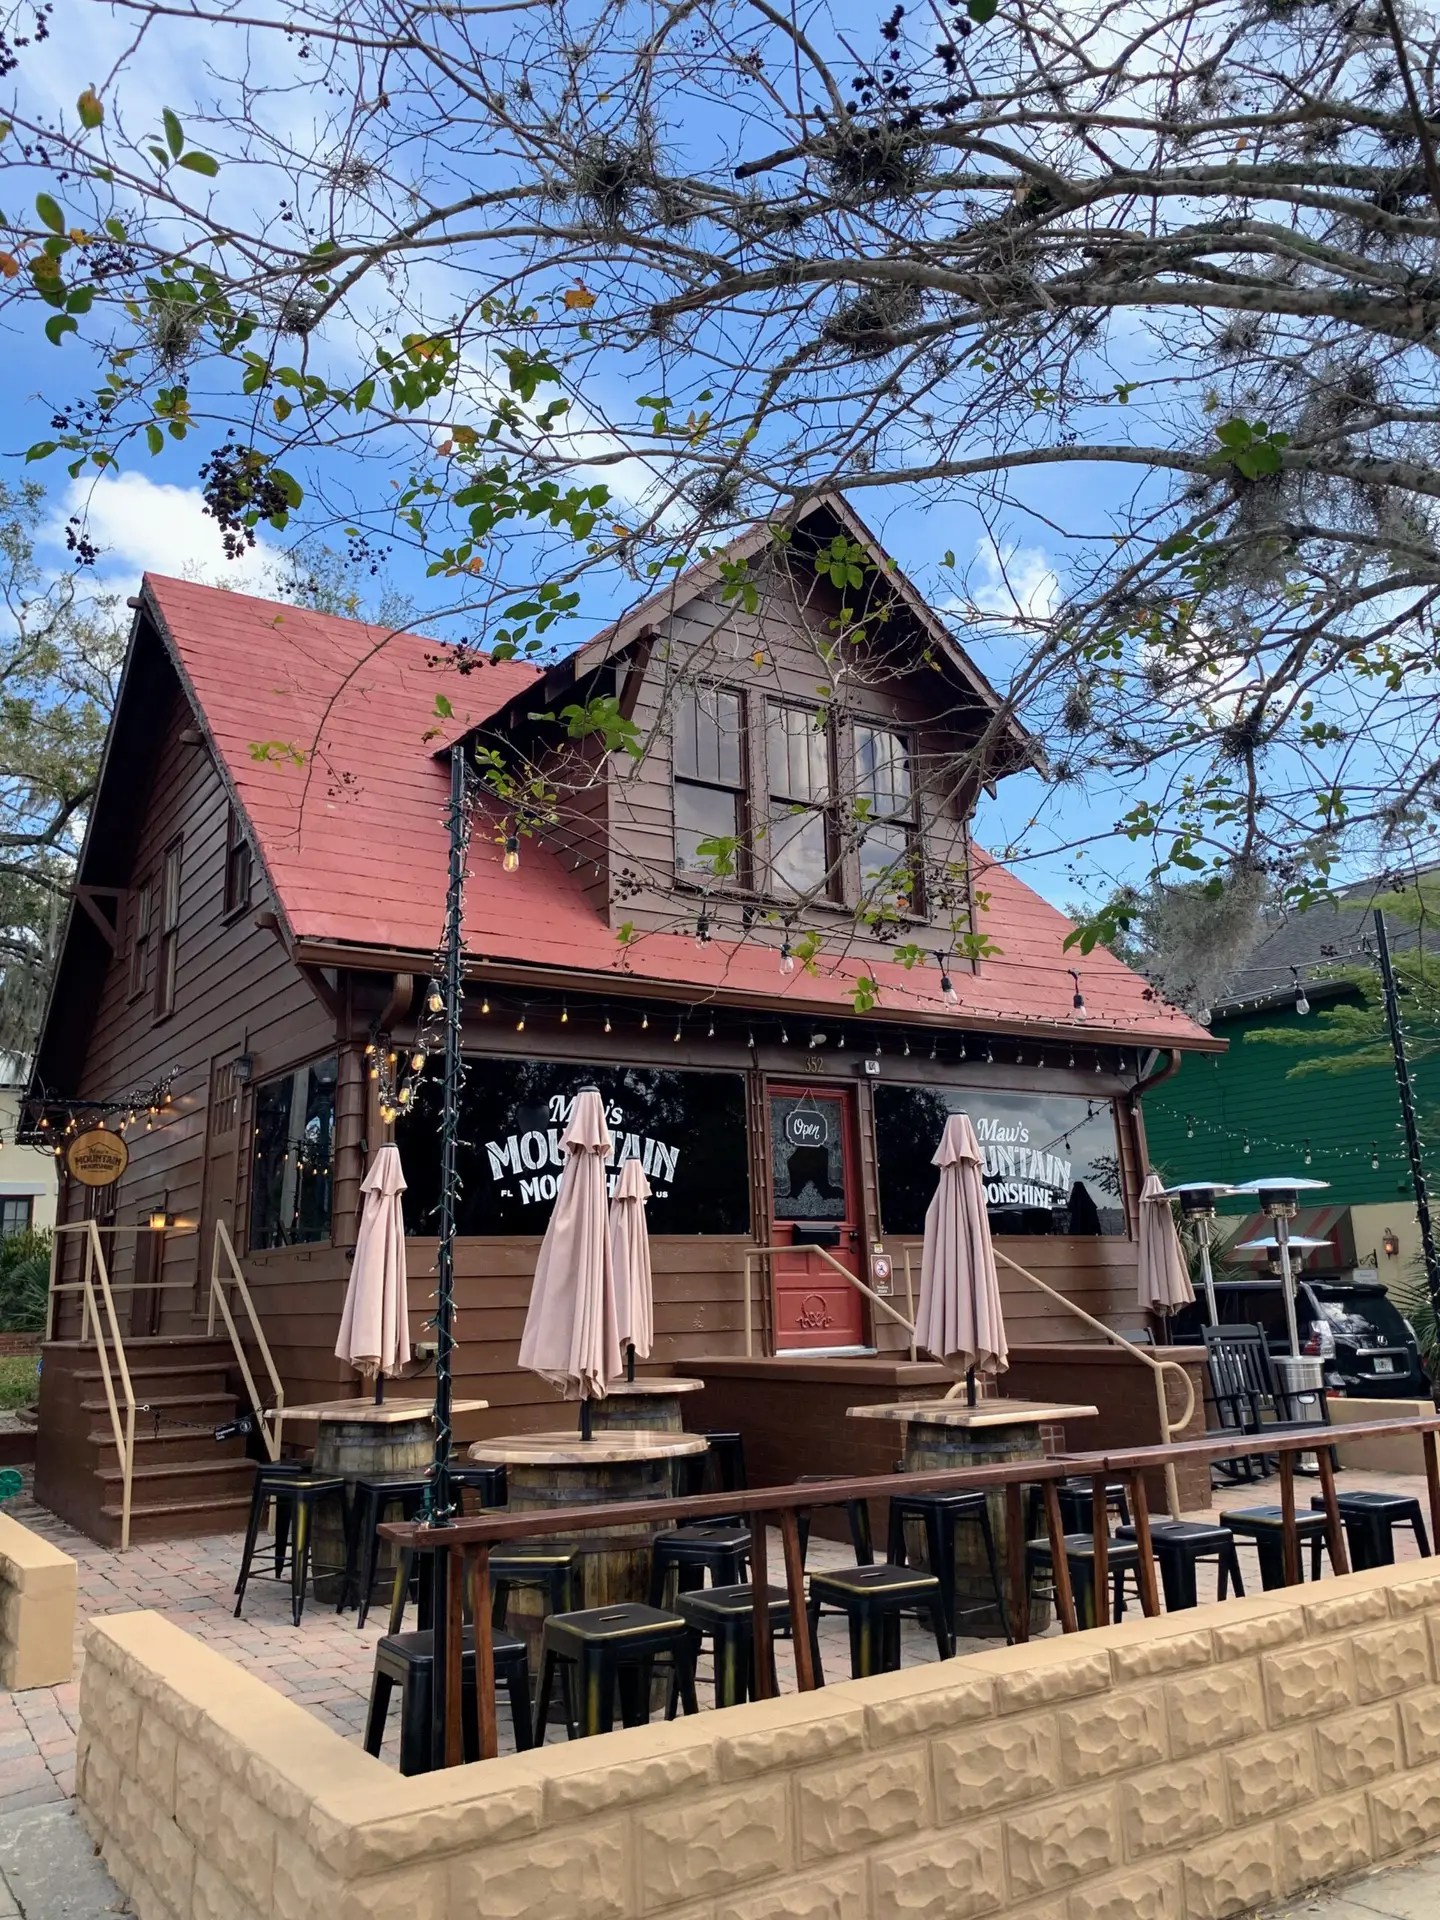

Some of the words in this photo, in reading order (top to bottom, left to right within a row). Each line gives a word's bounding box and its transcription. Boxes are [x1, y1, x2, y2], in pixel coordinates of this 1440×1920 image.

[805, 1056, 824, 1072] 352
[549, 1094, 623, 1125] M's
[794, 1118, 820, 1140] Open
[977, 1118, 1029, 1143] Maw's
[485, 1128, 680, 1183] MOUTAIN
[979, 1145, 1071, 1191] UNTAIN
[501, 1189, 513, 1197] FL
